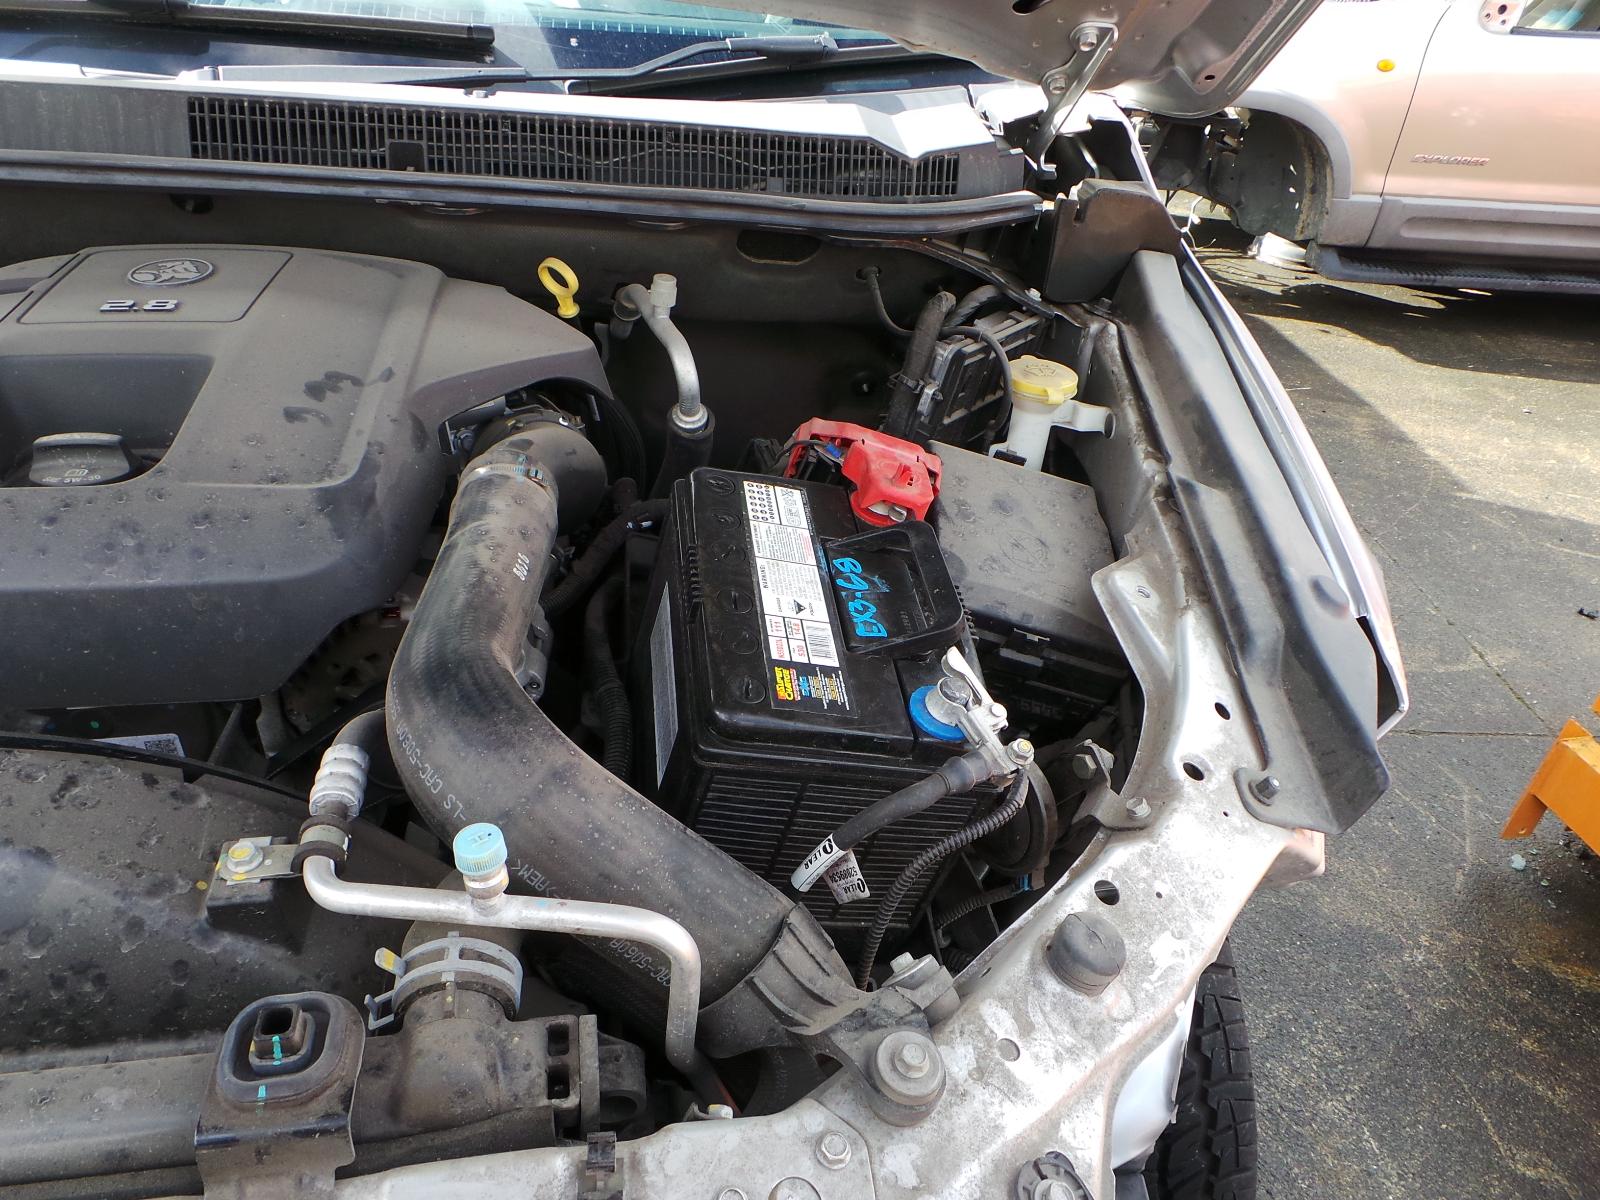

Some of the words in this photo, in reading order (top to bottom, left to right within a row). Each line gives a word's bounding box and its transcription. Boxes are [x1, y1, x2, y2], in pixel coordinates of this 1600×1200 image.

[99, 299, 179, 313] 2.8
[782, 668, 794, 701] CHARGE
[803, 850, 822, 870] LEAR
[842, 883, 858, 895] LEAR
